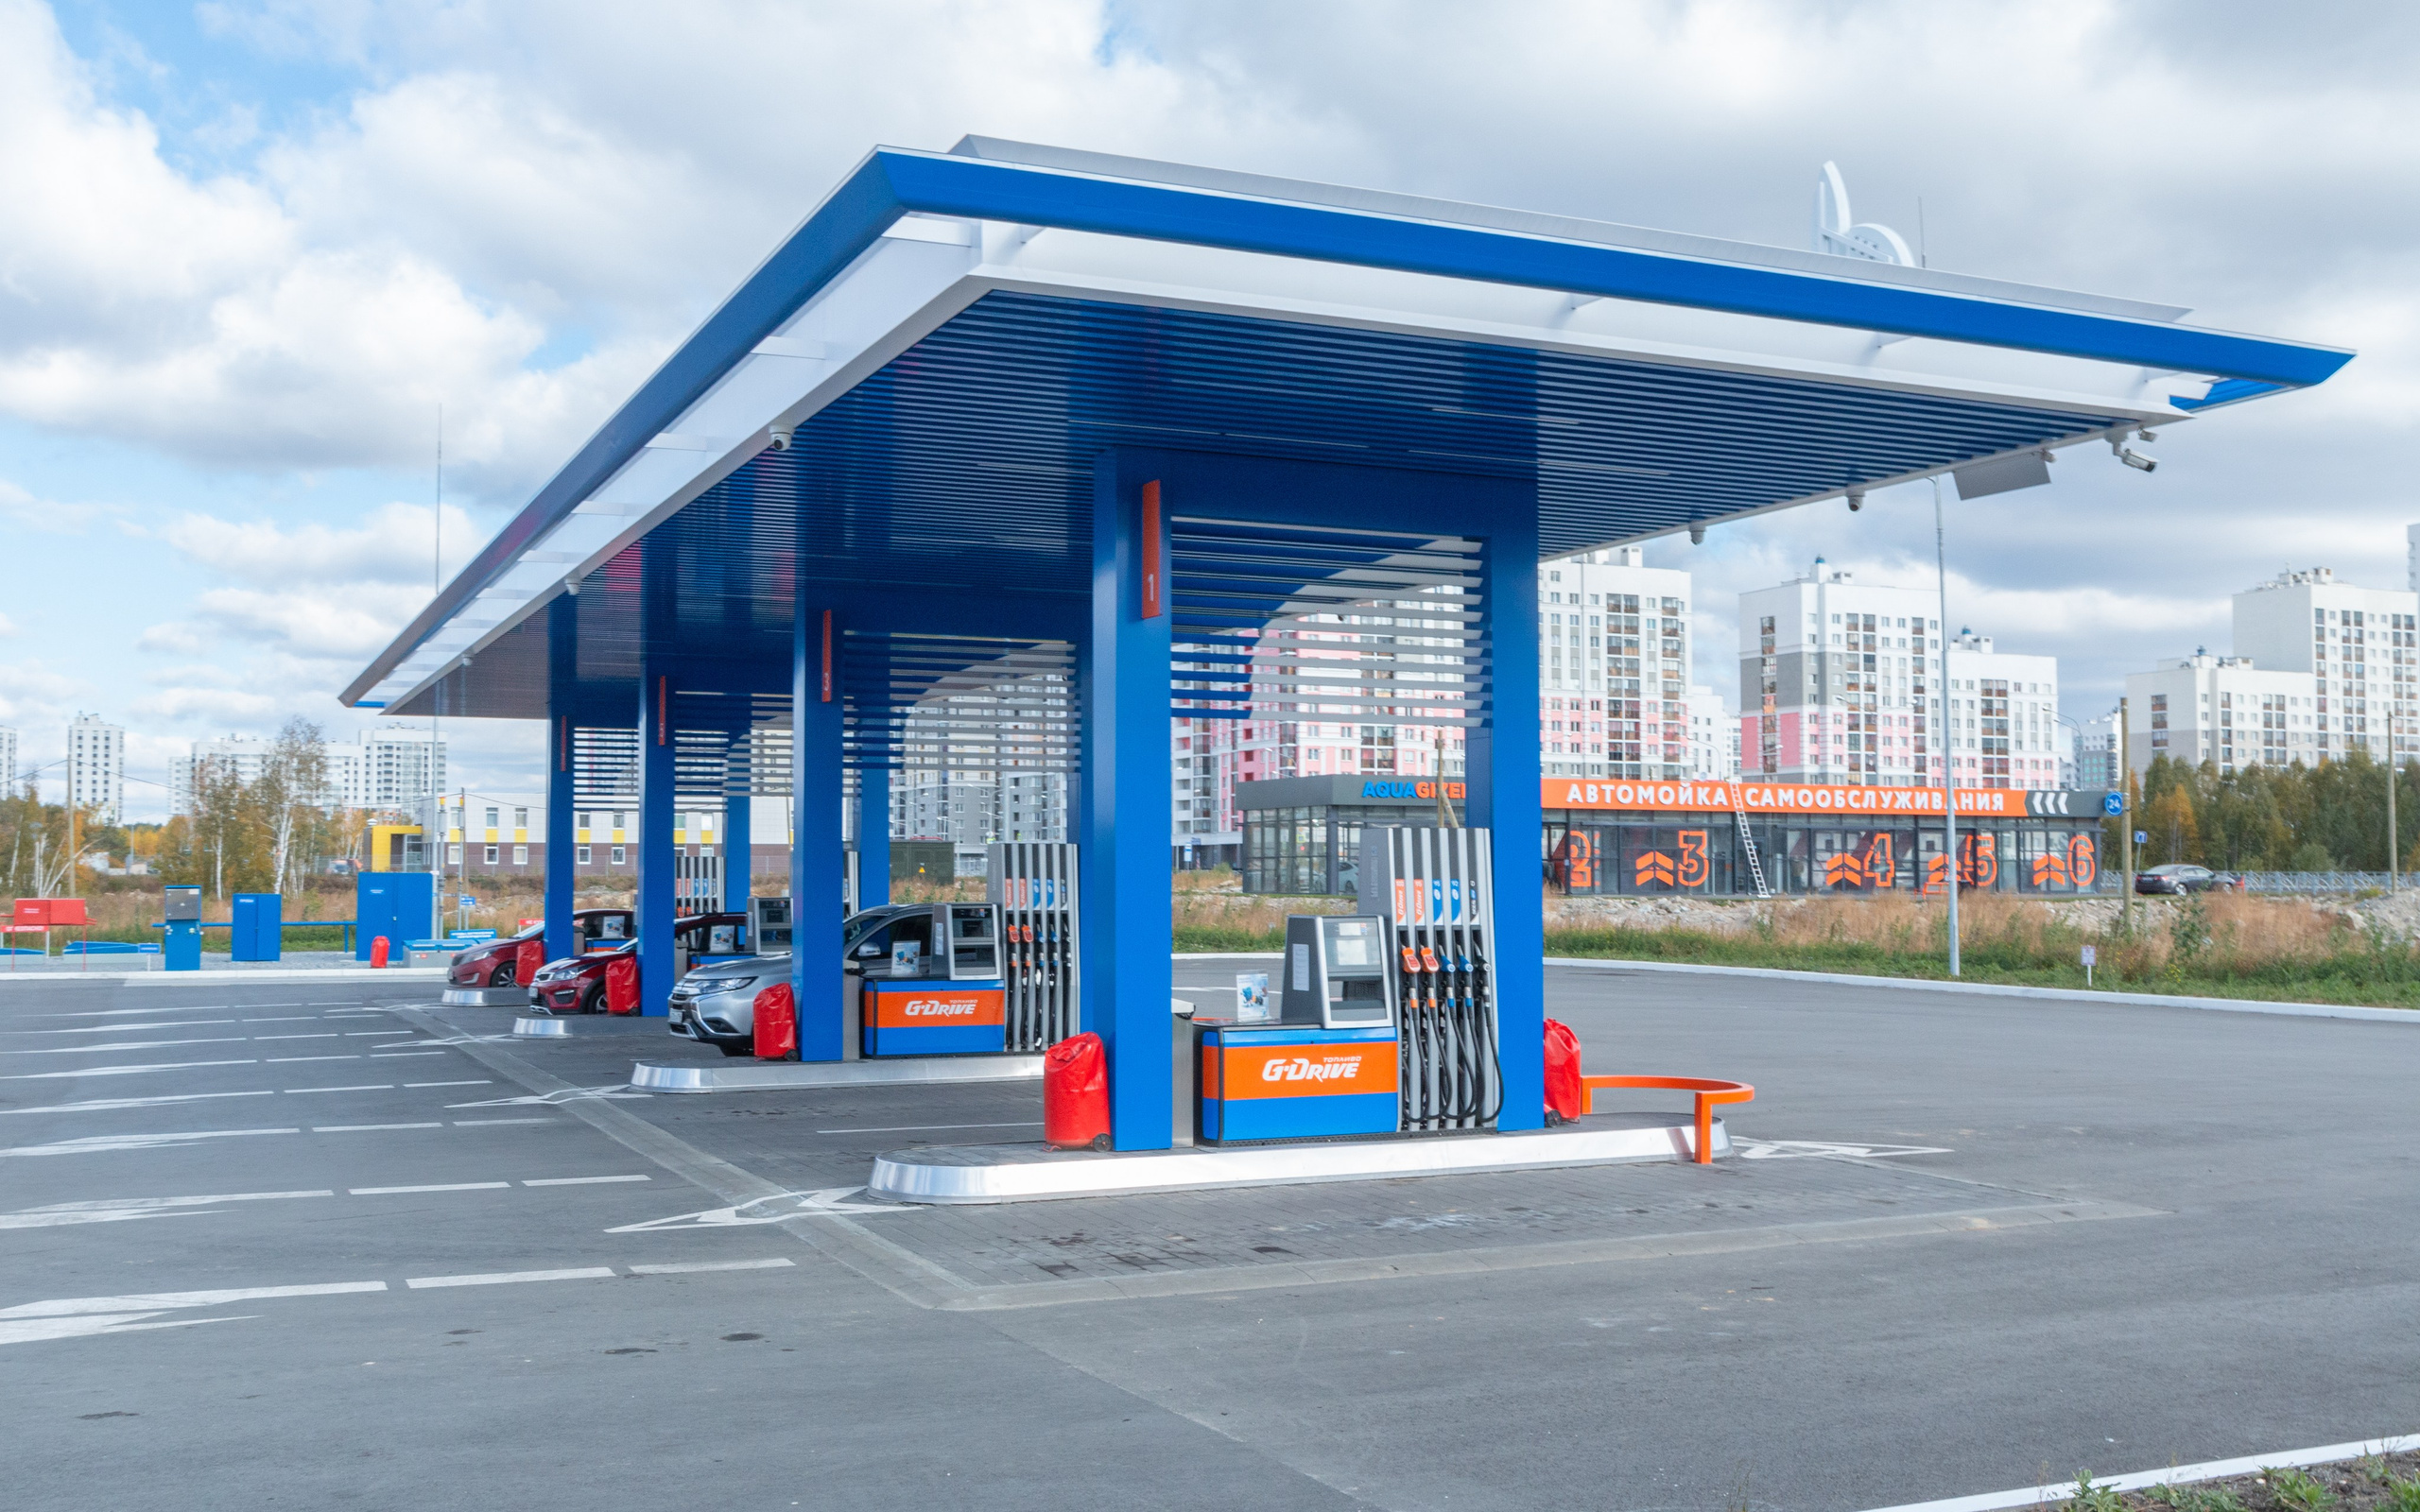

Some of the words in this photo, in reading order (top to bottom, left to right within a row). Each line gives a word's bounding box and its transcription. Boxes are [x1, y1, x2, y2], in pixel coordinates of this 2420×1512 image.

[1148, 573, 1154, 602] 1
[1362, 781, 1466, 799] AQUAGIE
[1565, 782, 1729, 806] АВТОМОЙКА
[2108, 799, 2121, 810] 24
[1678, 830, 1709, 887] 3
[1863, 833, 1895, 887] 4
[1963, 834, 1997, 887] 5
[2067, 834, 2096, 887] 6
